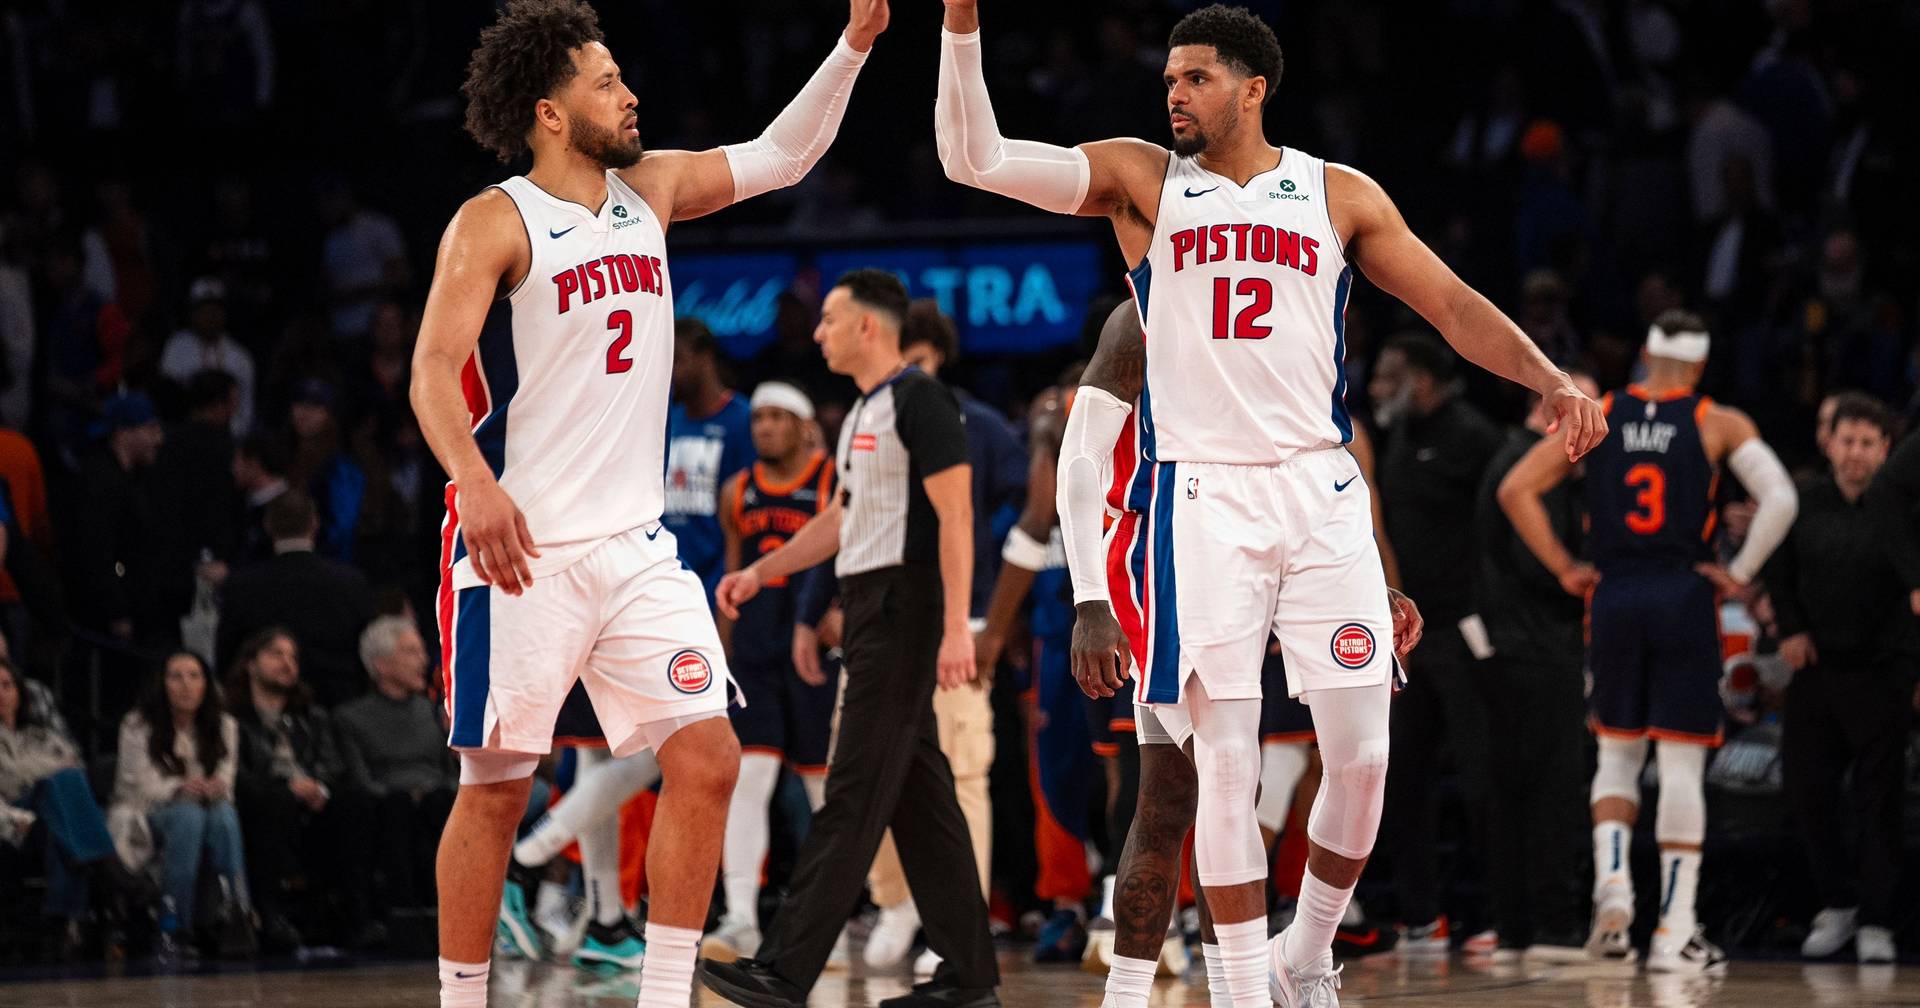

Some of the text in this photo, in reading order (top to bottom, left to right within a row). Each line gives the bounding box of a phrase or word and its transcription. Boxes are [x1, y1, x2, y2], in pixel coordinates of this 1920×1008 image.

[1268, 191, 1310, 202] StockX
[1170, 223, 1320, 277] PISTONS
[552, 253, 663, 315] PISTONS
[843, 263, 1069, 327] TRA
[1212, 276, 1273, 340] 12
[605, 309, 633, 375] 2
[1624, 462, 1666, 535] 3
[1339, 637, 1368, 647] DETROIT
[1339, 645, 1368, 655] PISTONS
